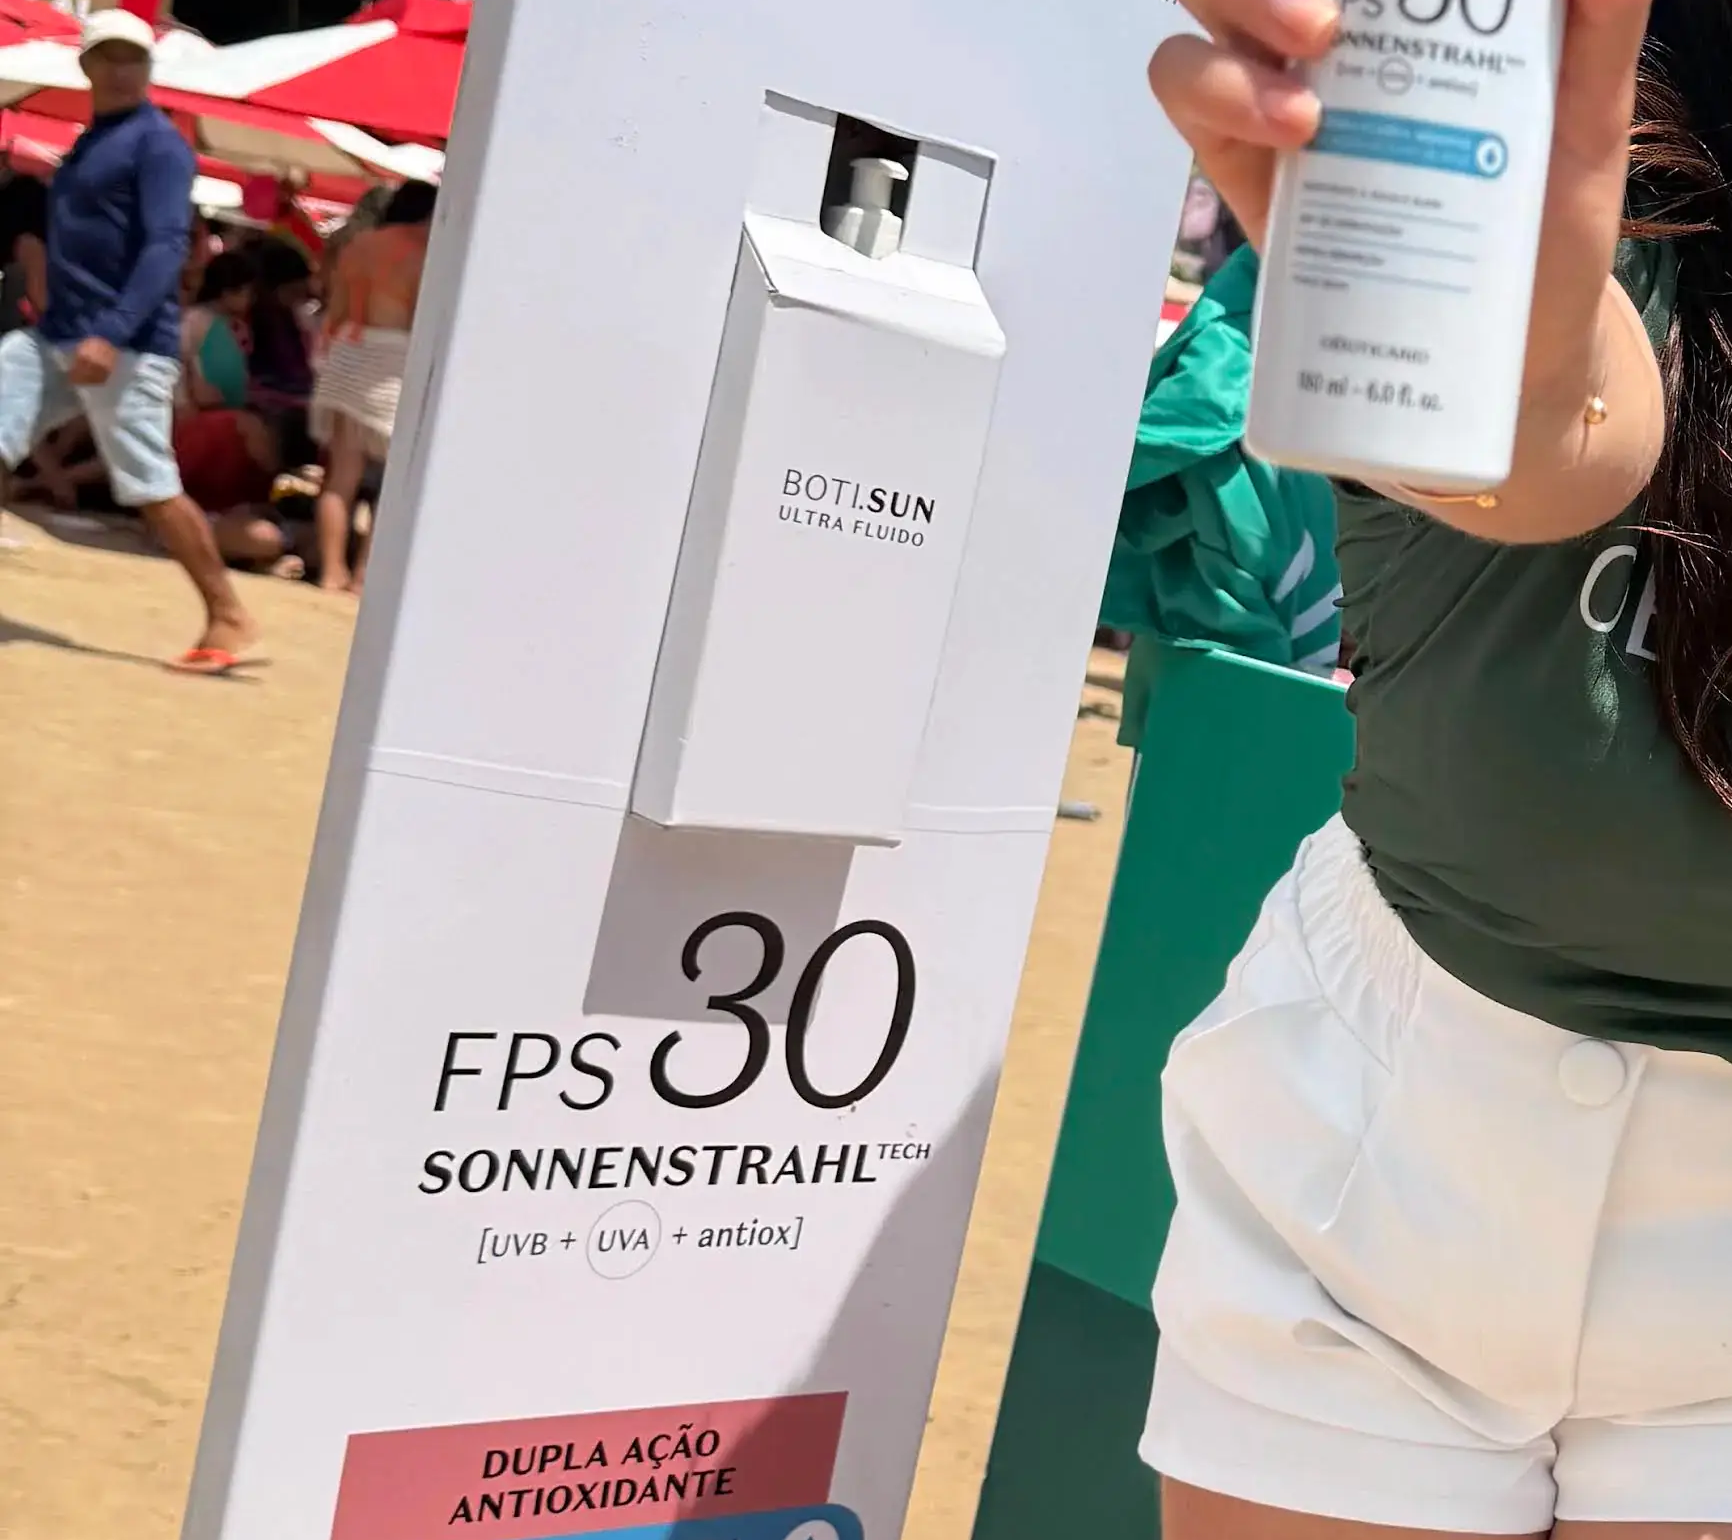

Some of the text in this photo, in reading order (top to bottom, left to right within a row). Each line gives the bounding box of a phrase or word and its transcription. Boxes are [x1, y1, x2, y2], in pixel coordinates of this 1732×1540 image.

[783, 469, 935, 525] BOTI.SUN
[779, 505, 925, 547] ULTRA FLUIDO
[432, 910, 917, 1113] FPS 30
[597, 1228, 651, 1255] UVA
[481, 1423, 721, 1481] DUPLA AÇÃO
[448, 1467, 737, 1526] ANTIOXIDANTE
